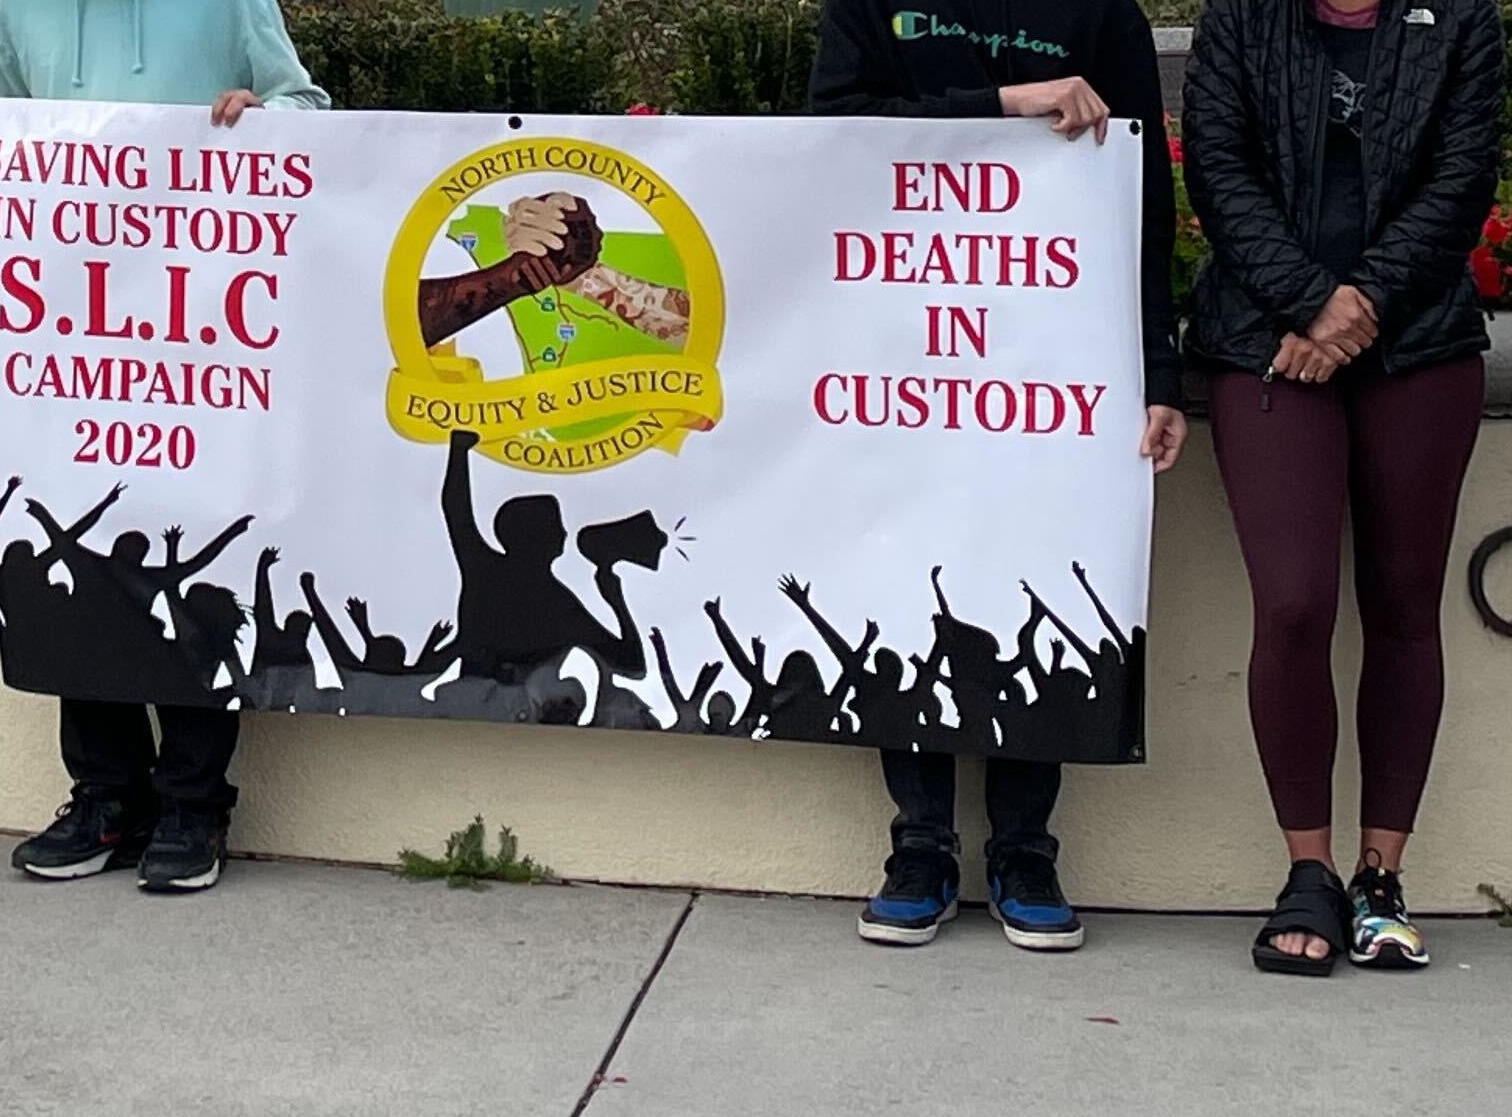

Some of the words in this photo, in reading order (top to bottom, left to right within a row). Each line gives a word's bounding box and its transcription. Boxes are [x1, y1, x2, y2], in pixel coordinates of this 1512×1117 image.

[168, 148, 314, 199] LIVES
[440, 147, 537, 205] NORTH
[544, 146, 666, 208] COUNTY
[891, 162, 1022, 213] END
[51, 200, 297, 257] CUSTODY
[833, 231, 1080, 289] DEATHS
[925, 305, 989, 358] IN
[4, 352, 271, 412] CAMPAIGN
[406, 393, 527, 430] EQUITY
[538, 392, 558, 415] &
[567, 370, 704, 408] JUSTICE
[813, 373, 1108, 436] CUSTODY
[73, 418, 196, 471] 2020
[504, 411, 666, 469] COALITION
